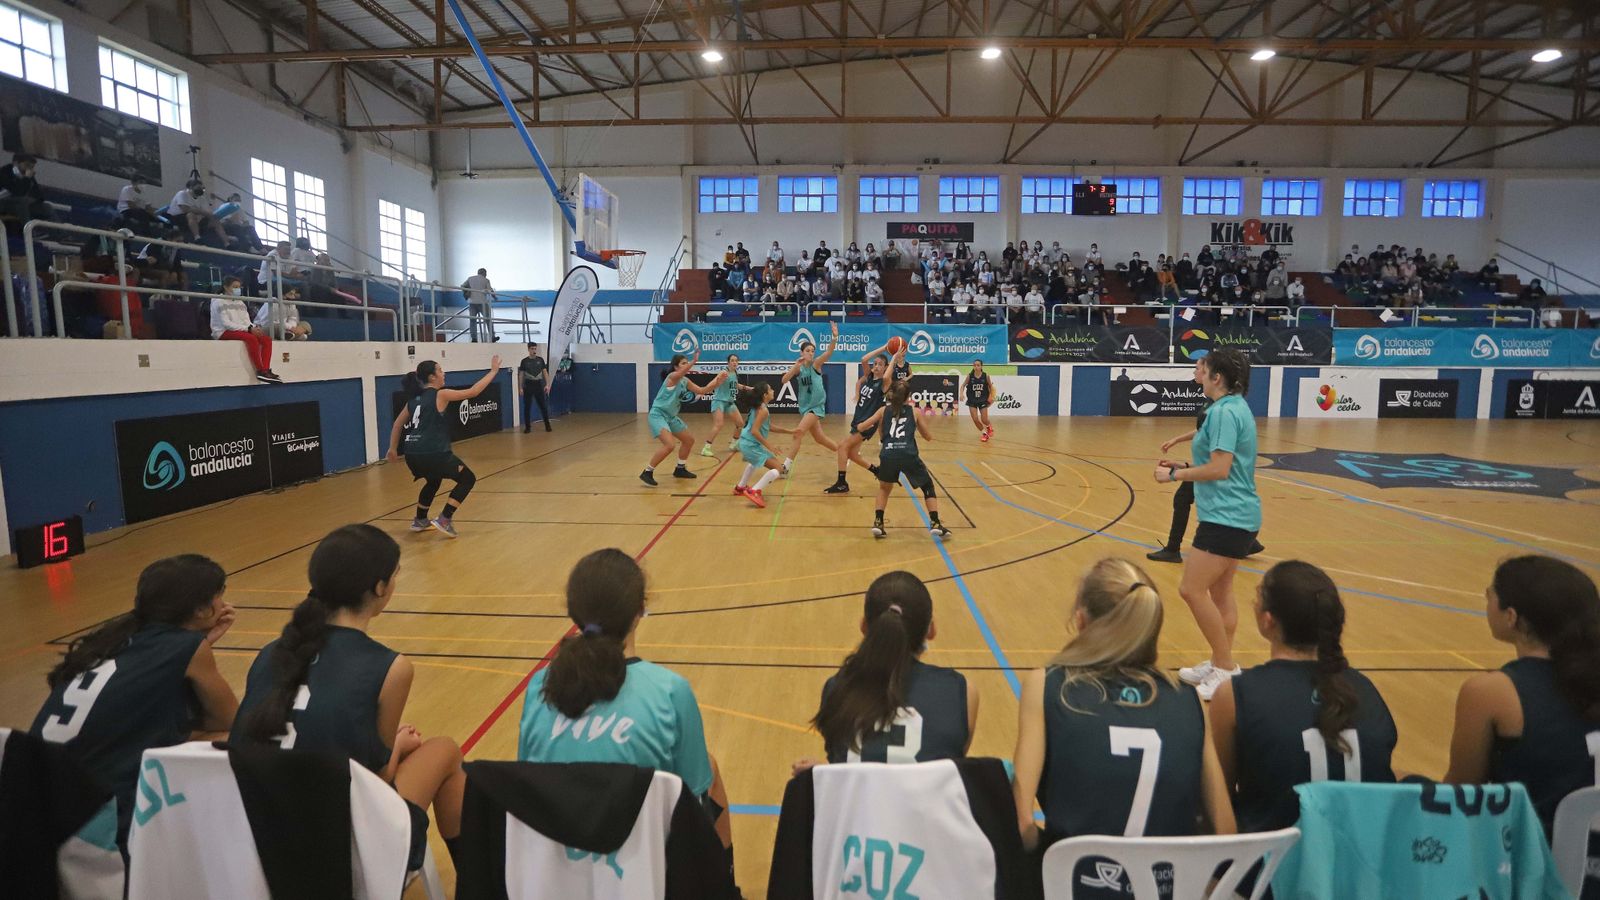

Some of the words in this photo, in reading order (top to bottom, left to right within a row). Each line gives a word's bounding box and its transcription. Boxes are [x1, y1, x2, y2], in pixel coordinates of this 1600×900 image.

[901, 223, 959, 235] PAQUITA
[564, 302, 585, 337] andalucía
[702, 332, 752, 342] baloncesto
[938, 334, 989, 344] baloncesto
[1384, 336, 1434, 347] baloncesto
[1501, 337, 1552, 348] baloncesto
[702, 341, 749, 351] andalucía
[938, 343, 986, 354] andalucía
[1384, 346, 1431, 356] andalucía
[1502, 347, 1549, 358] andalucía
[700, 364, 793, 373] SUPEMERCADOS
[1413, 390, 1449, 402] Diputación
[997, 400, 1022, 410] cesto
[1337, 401, 1362, 412] cesto
[1423, 398, 1442, 408] Cádiz
[889, 417, 908, 439] 12
[189, 436, 254, 462] baloncesto
[190, 451, 252, 478] andalucía
[44, 521, 68, 559] 16
[41, 659, 117, 744] 9
[1301, 727, 1362, 782] 11
[1108, 724, 1162, 837] 7
